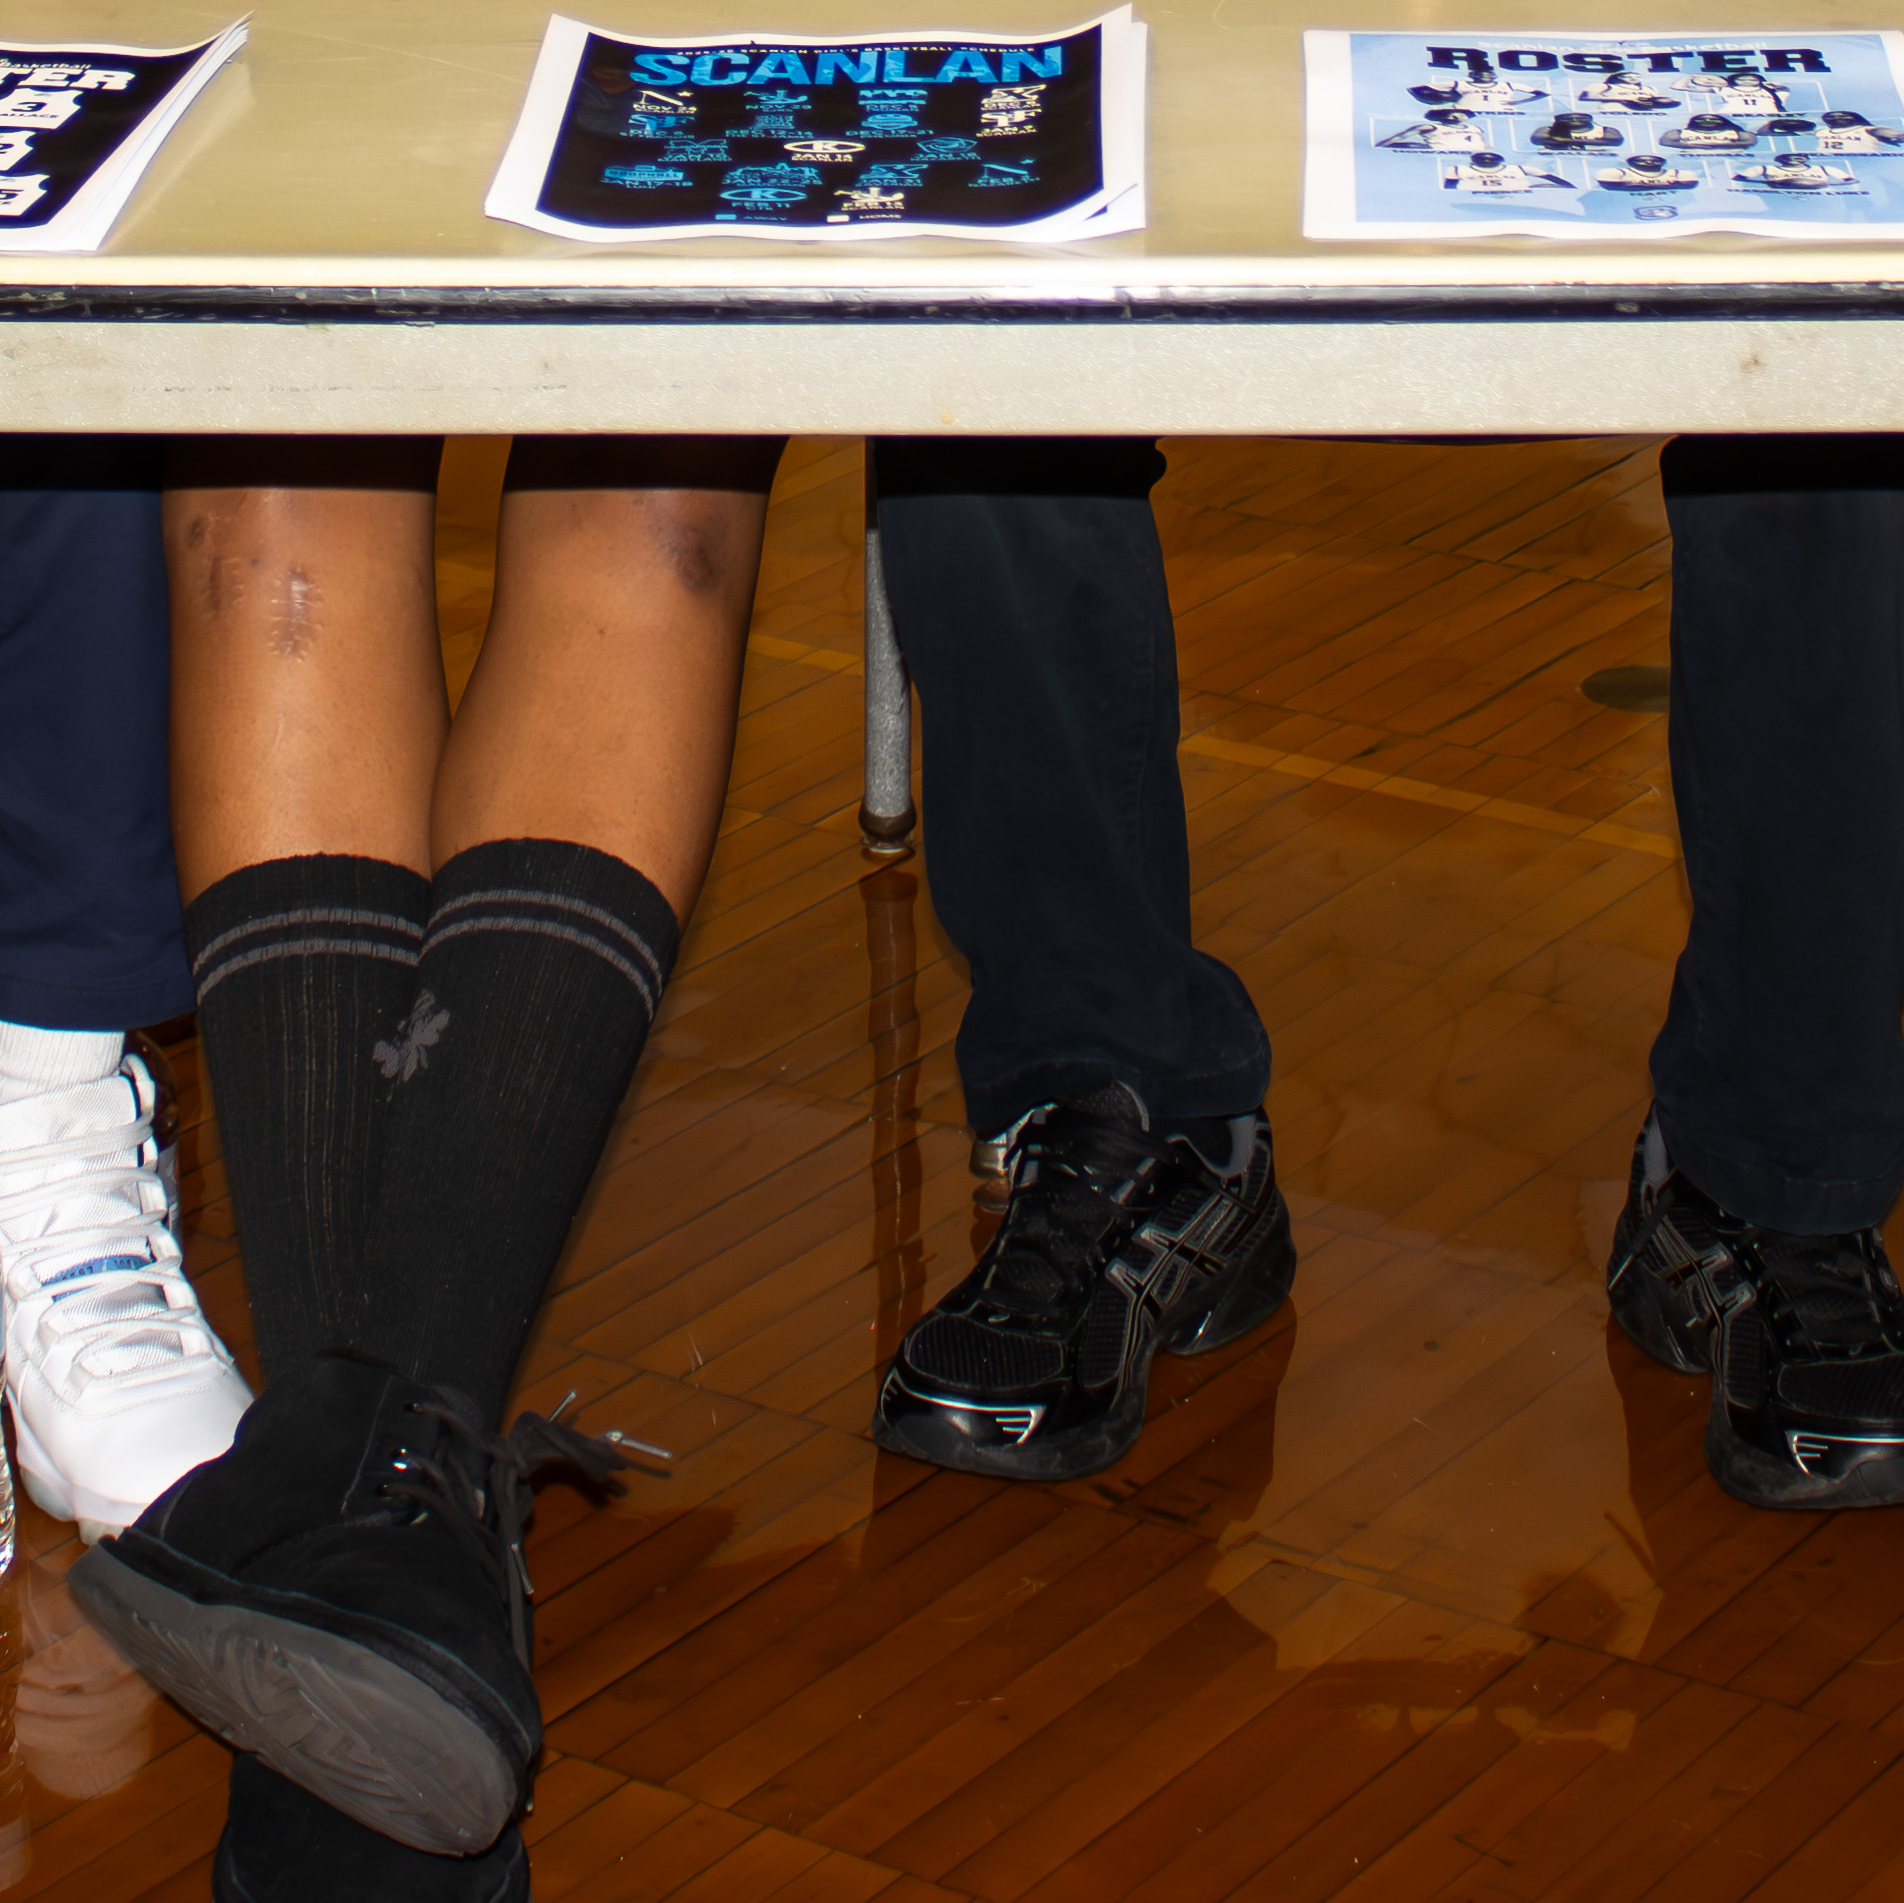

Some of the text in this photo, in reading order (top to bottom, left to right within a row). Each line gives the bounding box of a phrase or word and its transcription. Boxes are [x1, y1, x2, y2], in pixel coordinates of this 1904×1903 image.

[629, 45, 1063, 86] SCANLAN
[1426, 46, 1832, 73] ROSTER
[11, 101, 47, 113] 3
[1823, 141, 1843, 150] 12
[1726, 188, 1823, 196] HAMILTON
